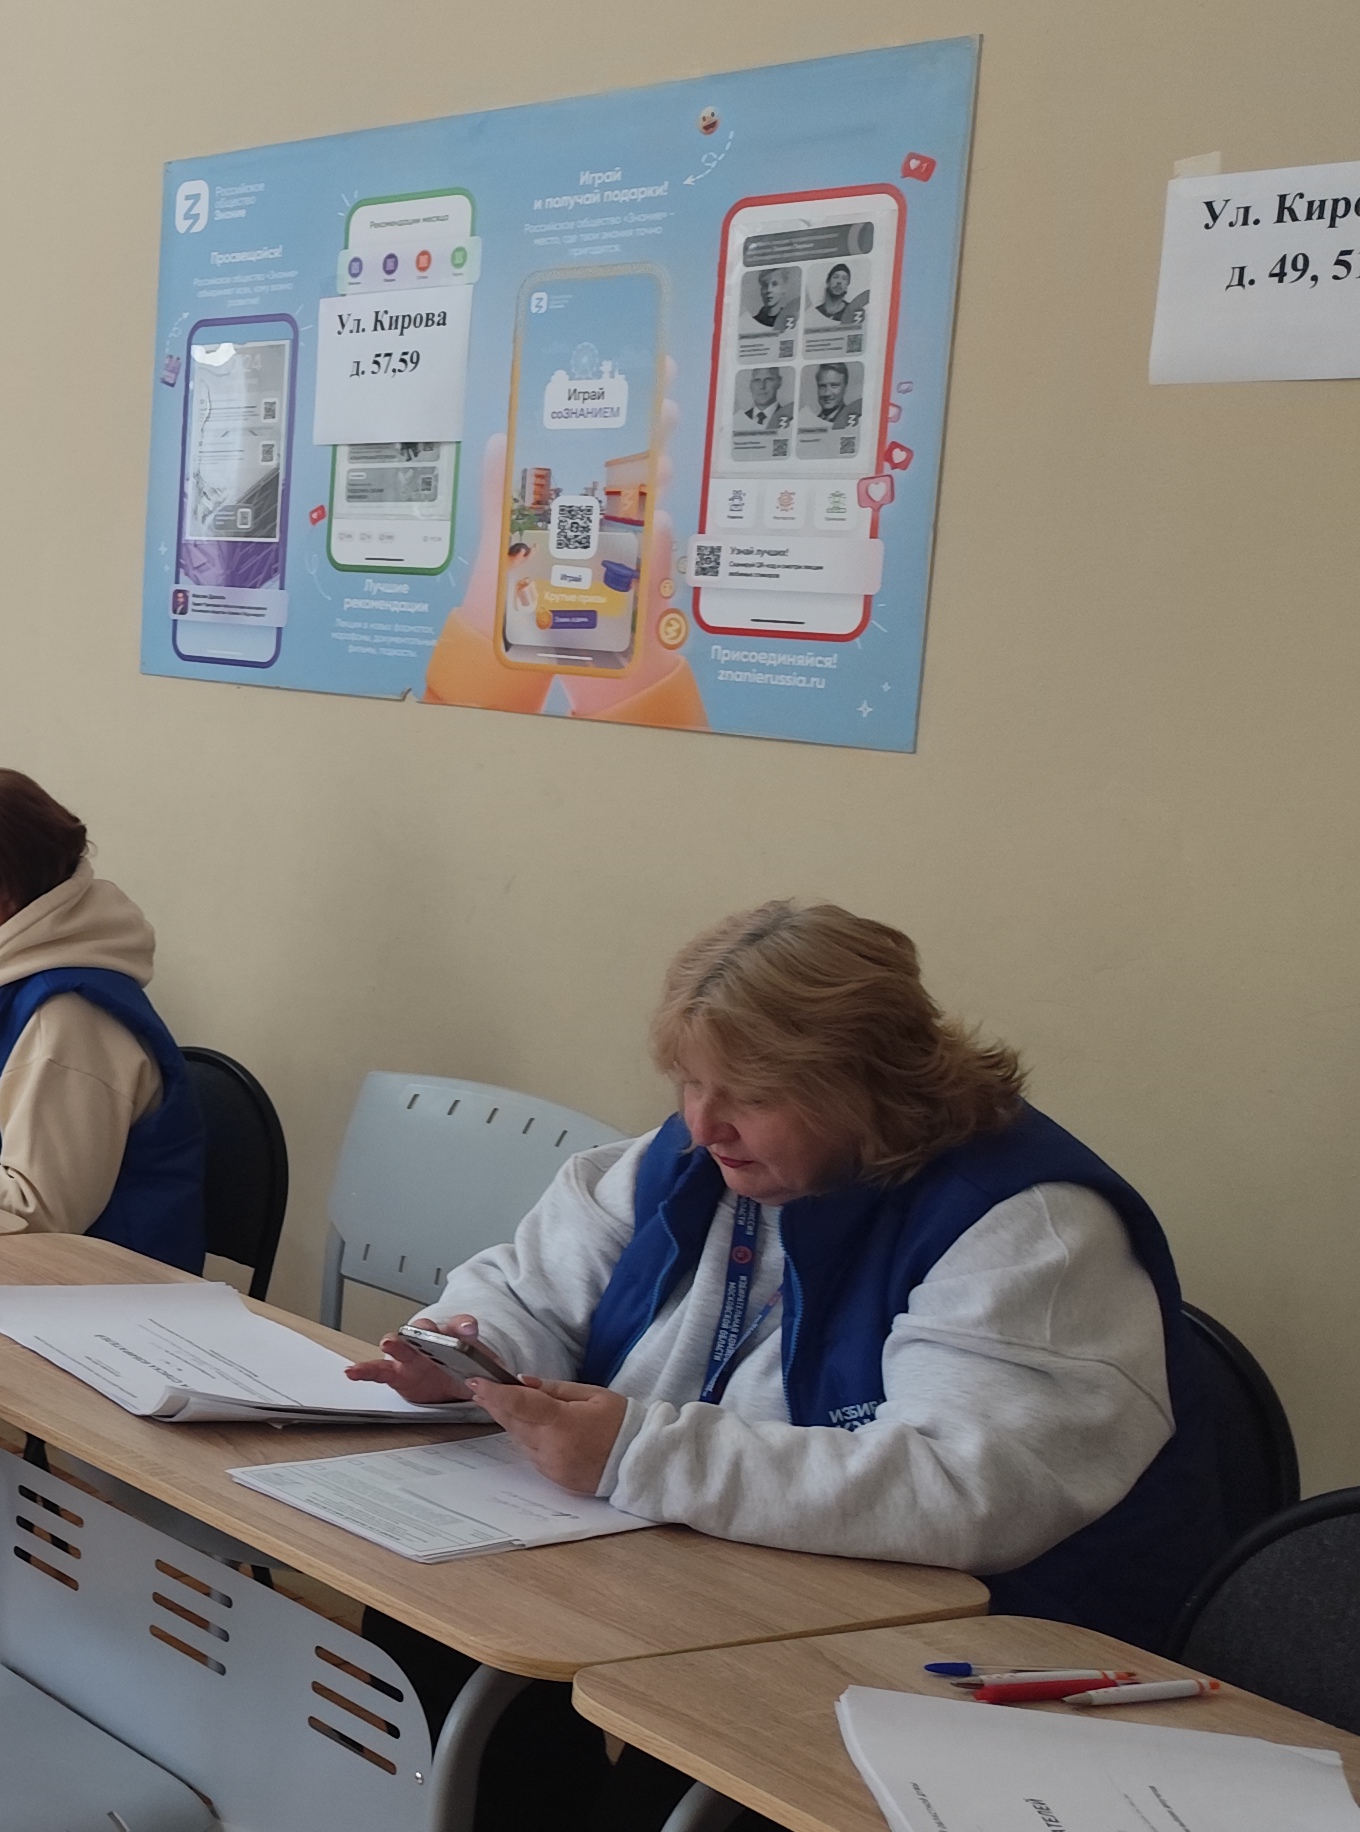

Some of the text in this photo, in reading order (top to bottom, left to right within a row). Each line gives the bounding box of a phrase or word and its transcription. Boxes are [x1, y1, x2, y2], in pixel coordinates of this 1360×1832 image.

[579, 166, 622, 187] Играй
[533, 181, 669, 210] и получай подарки!
[1202, 191, 1360, 231] Ул. Кир
[1224, 265, 1256, 291] д.
[1267, 252, 1319, 290] 49,
[336, 309, 448, 337] Ул. Кирова
[348, 349, 421, 379] д. 57,59
[566, 386, 606, 404] Играй
[550, 405, 621, 421] соЗНАНИЕМ
[710, 644, 839, 669] Присоединяйся!
[717, 668, 826, 689] znanierussia.ru
